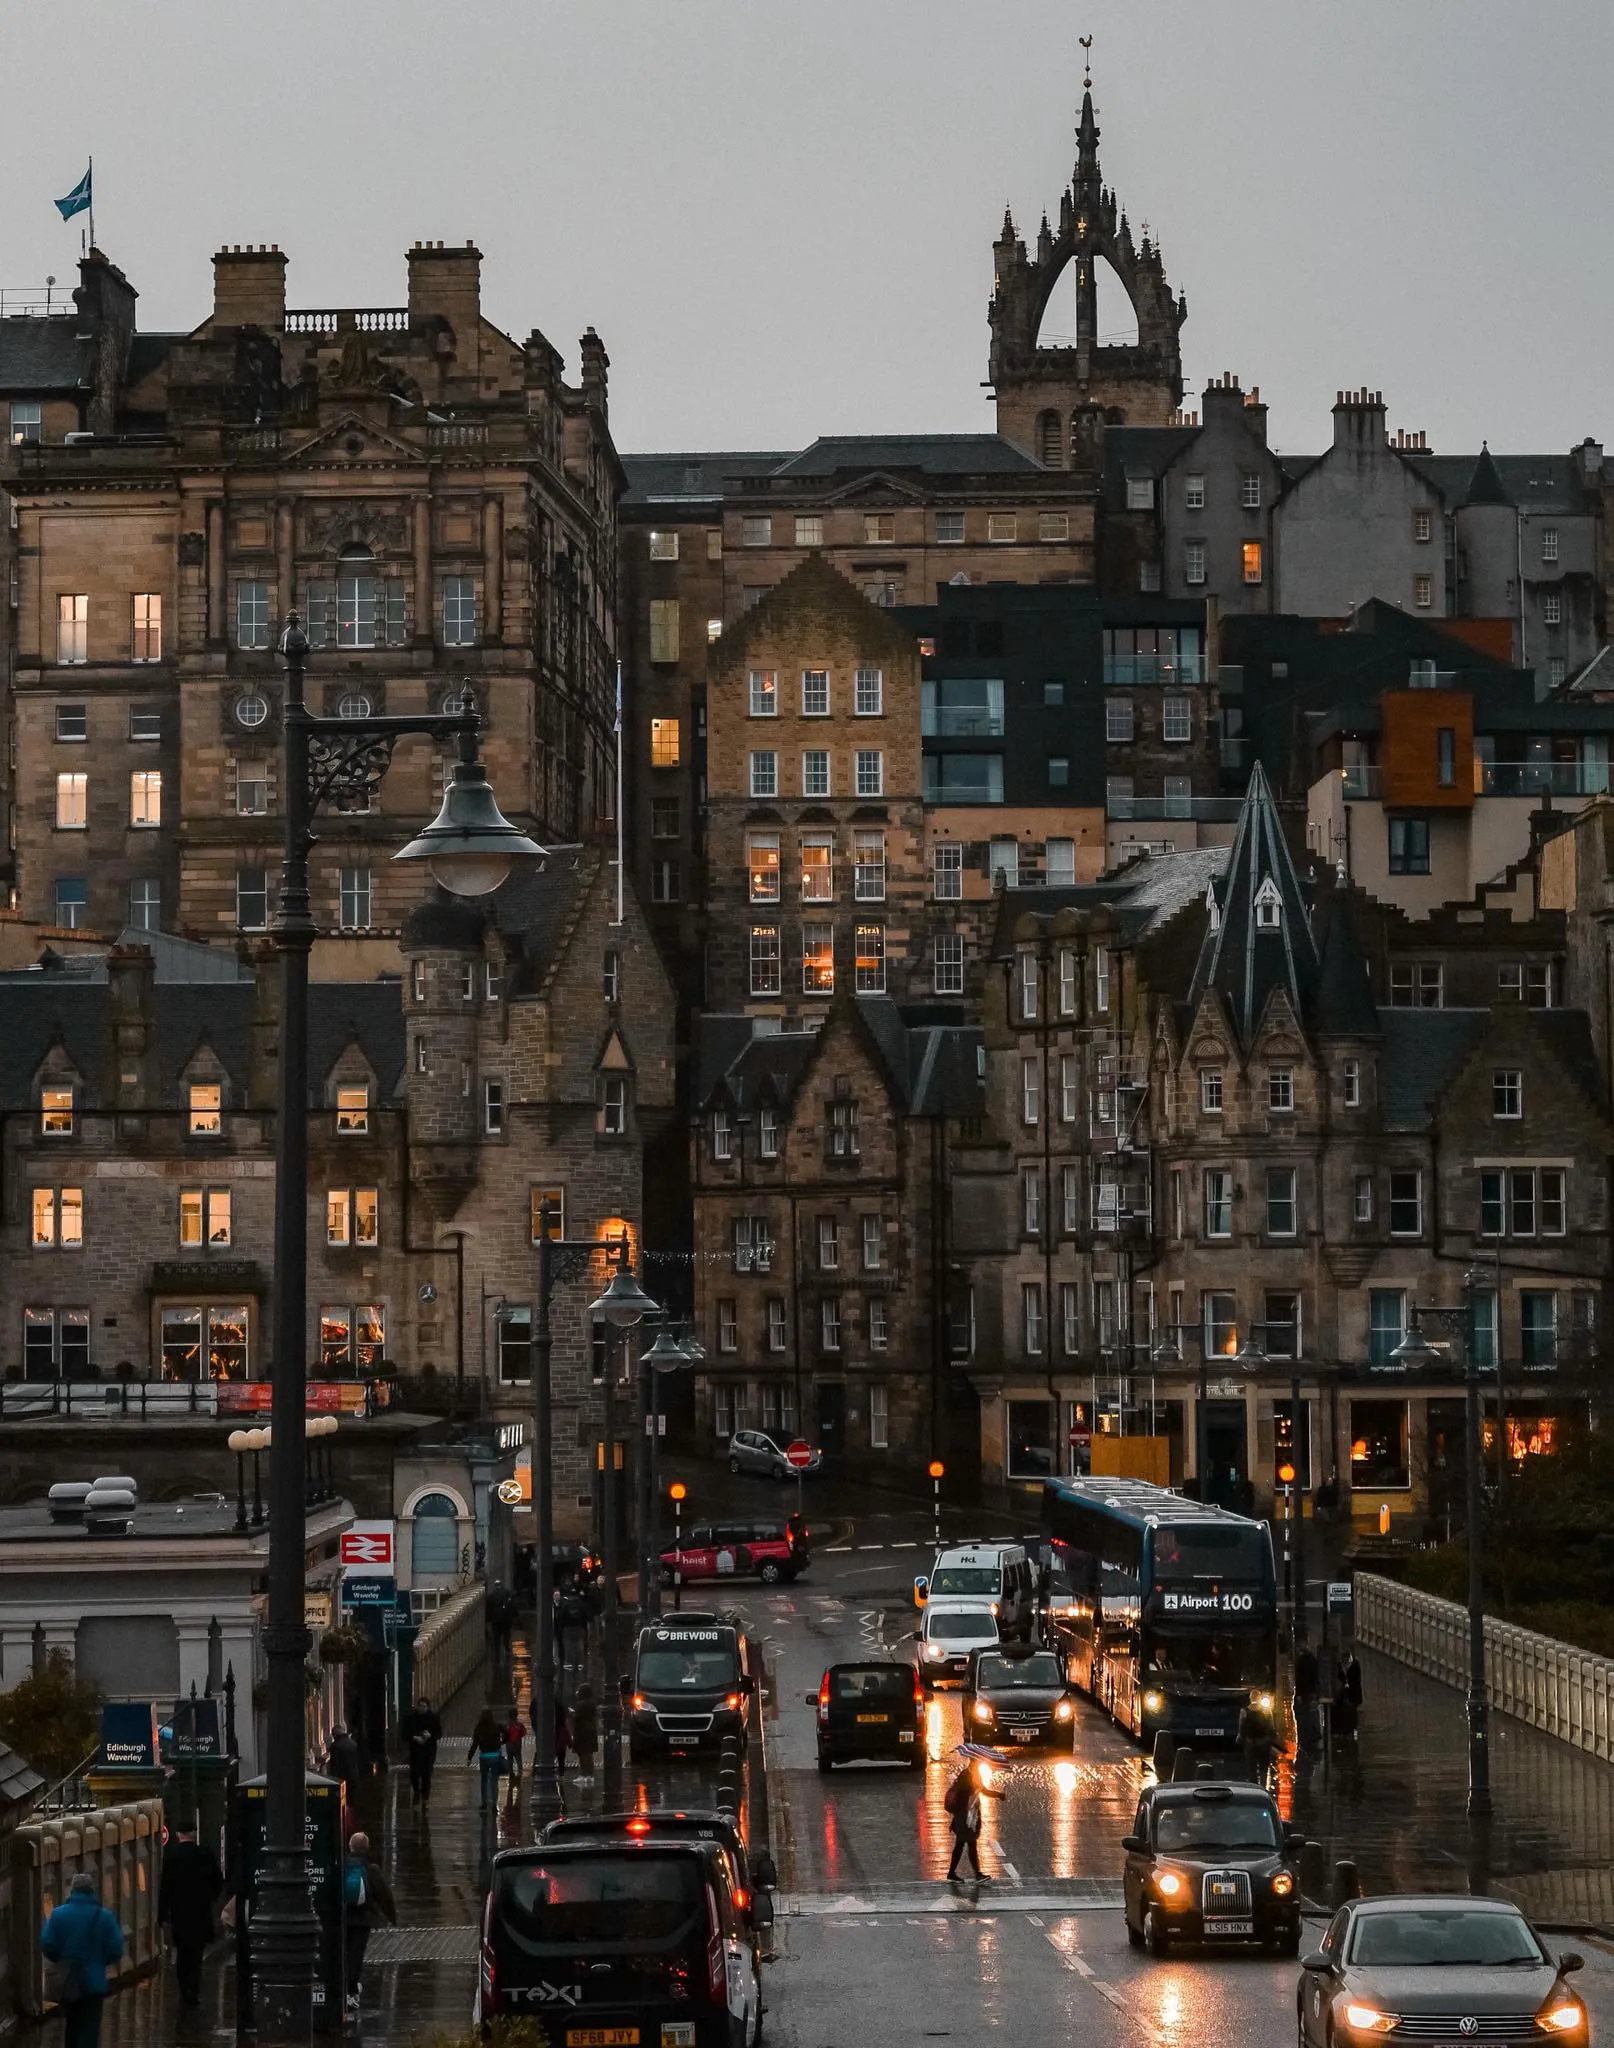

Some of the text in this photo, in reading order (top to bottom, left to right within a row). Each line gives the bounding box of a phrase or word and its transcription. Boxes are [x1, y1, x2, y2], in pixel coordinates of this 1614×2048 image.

[752, 927, 776, 936] Zizzi
[857, 926, 880, 935] Zizzi
[351, 1584, 381, 1592] Edinburgh
[1180, 1593, 1253, 1611] Airport 100
[670, 1631, 718, 1641] BREWDOG
[106, 1743, 146, 1753] Edinburgh
[106, 1753, 143, 1762] Waverley
[1210, 1922, 1248, 1932] LS15 HNX
[501, 1980, 582, 2006] TAXI
[608, 2030, 633, 2043] JVY
